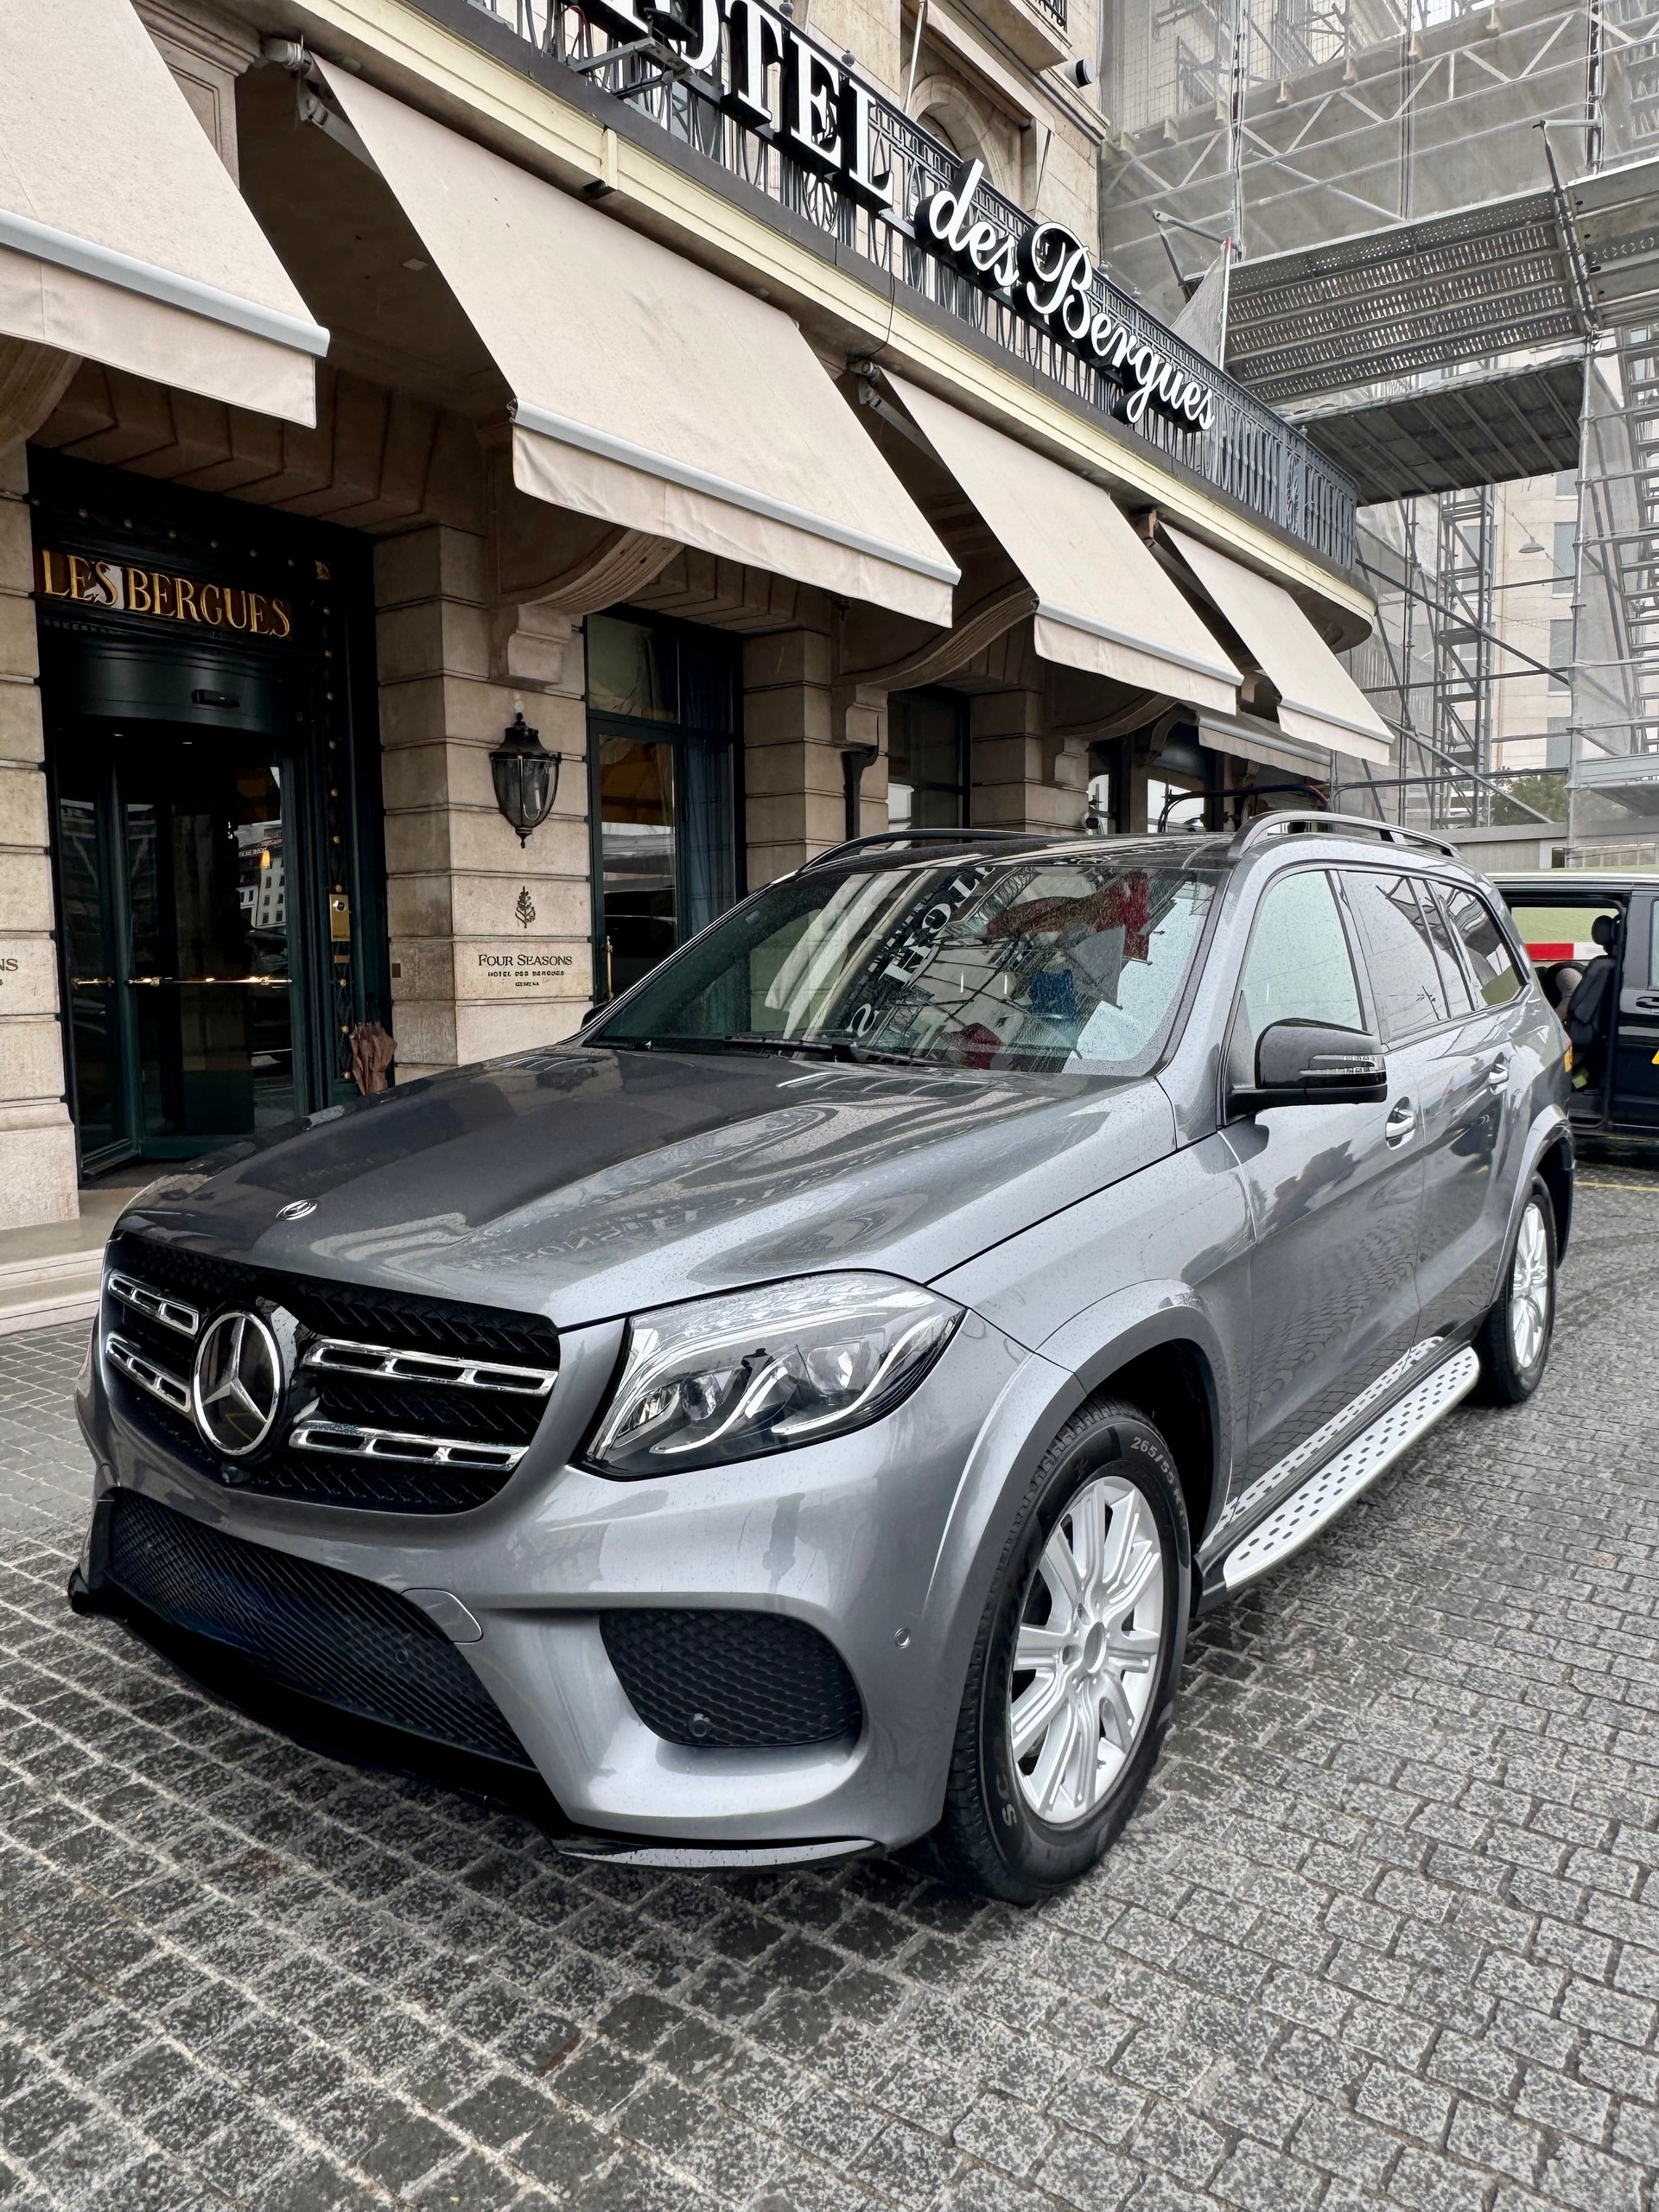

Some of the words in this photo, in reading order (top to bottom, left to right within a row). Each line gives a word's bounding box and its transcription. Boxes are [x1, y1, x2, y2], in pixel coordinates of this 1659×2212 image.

[928, 158, 1020, 287] des
[1026, 221, 1216, 431] Bergues
[42, 548, 118, 607] LES
[127, 567, 290, 638] BERGUES
[478, 954, 514, 967] FOUR
[517, 953, 573, 966] SEASONS
[1130, 1436, 1175, 1484] 265/55
